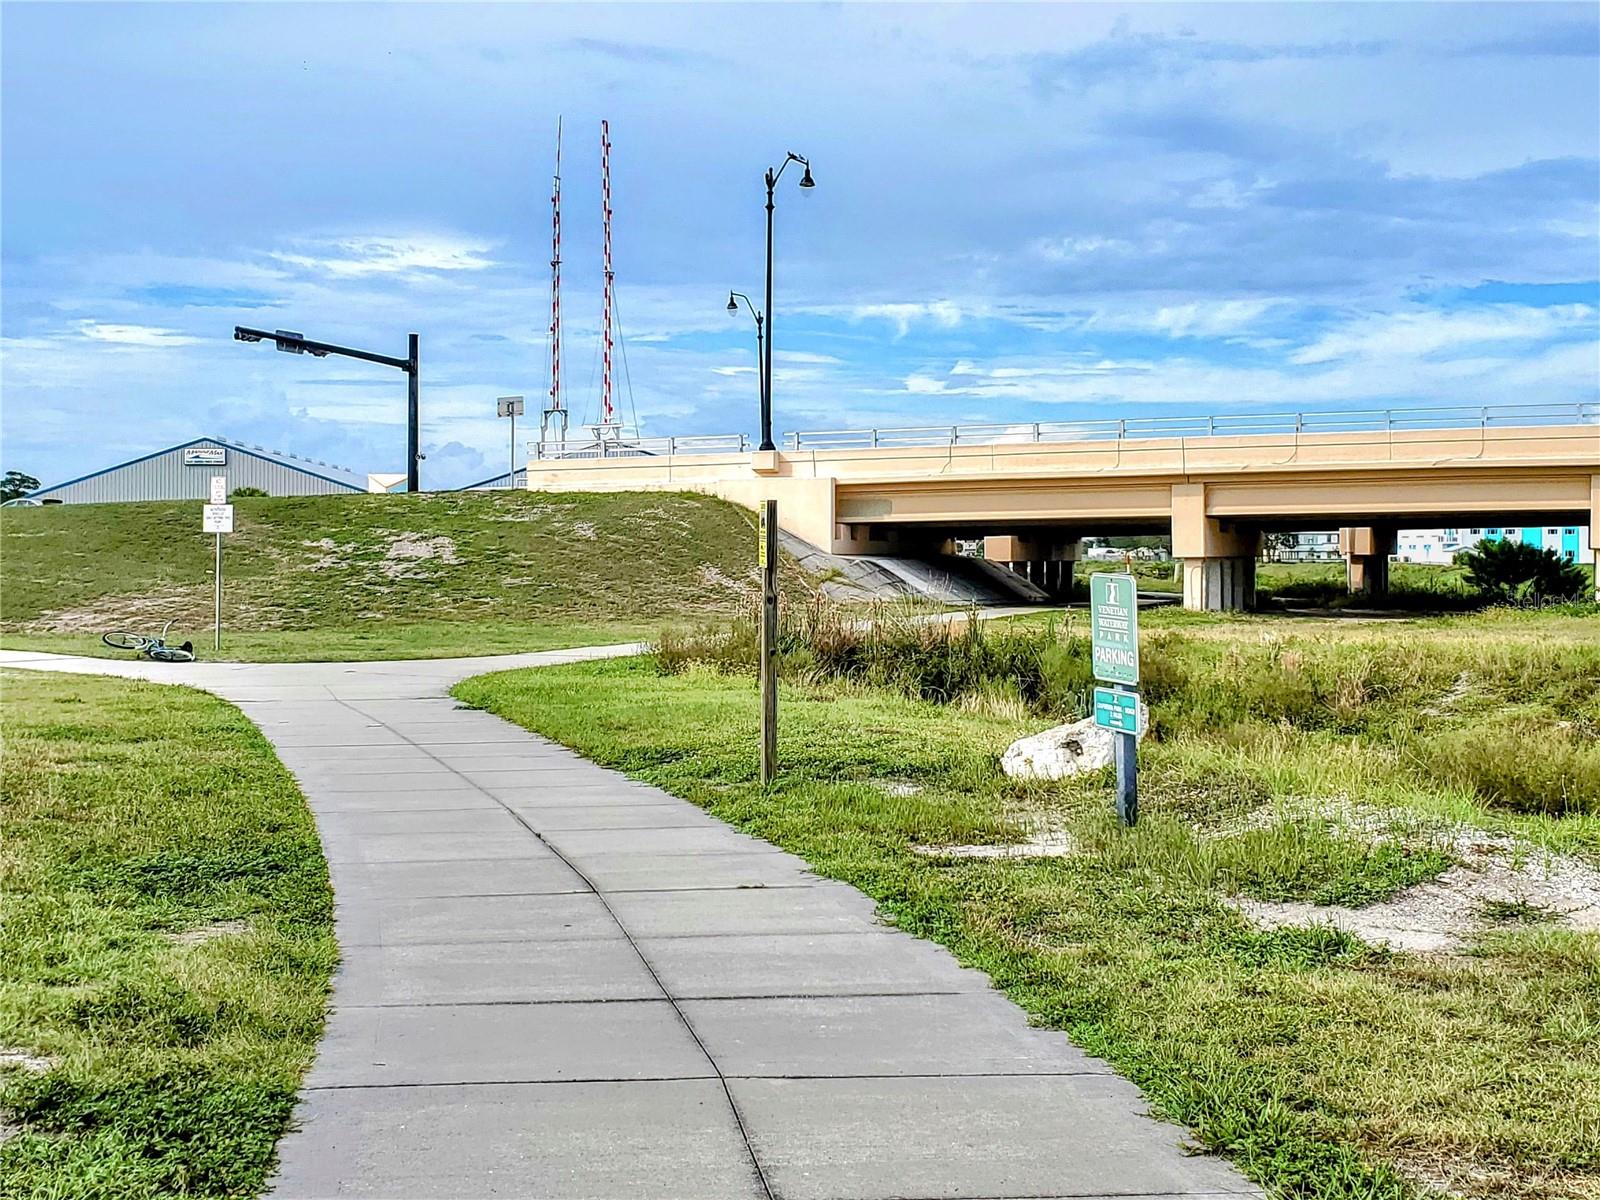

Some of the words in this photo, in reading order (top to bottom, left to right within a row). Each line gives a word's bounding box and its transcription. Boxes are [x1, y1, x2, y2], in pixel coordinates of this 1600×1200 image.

[1098, 605, 1129, 617] VENETIAN
[1099, 631, 1129, 643] PARK
[1095, 646, 1135, 667] PARKING
